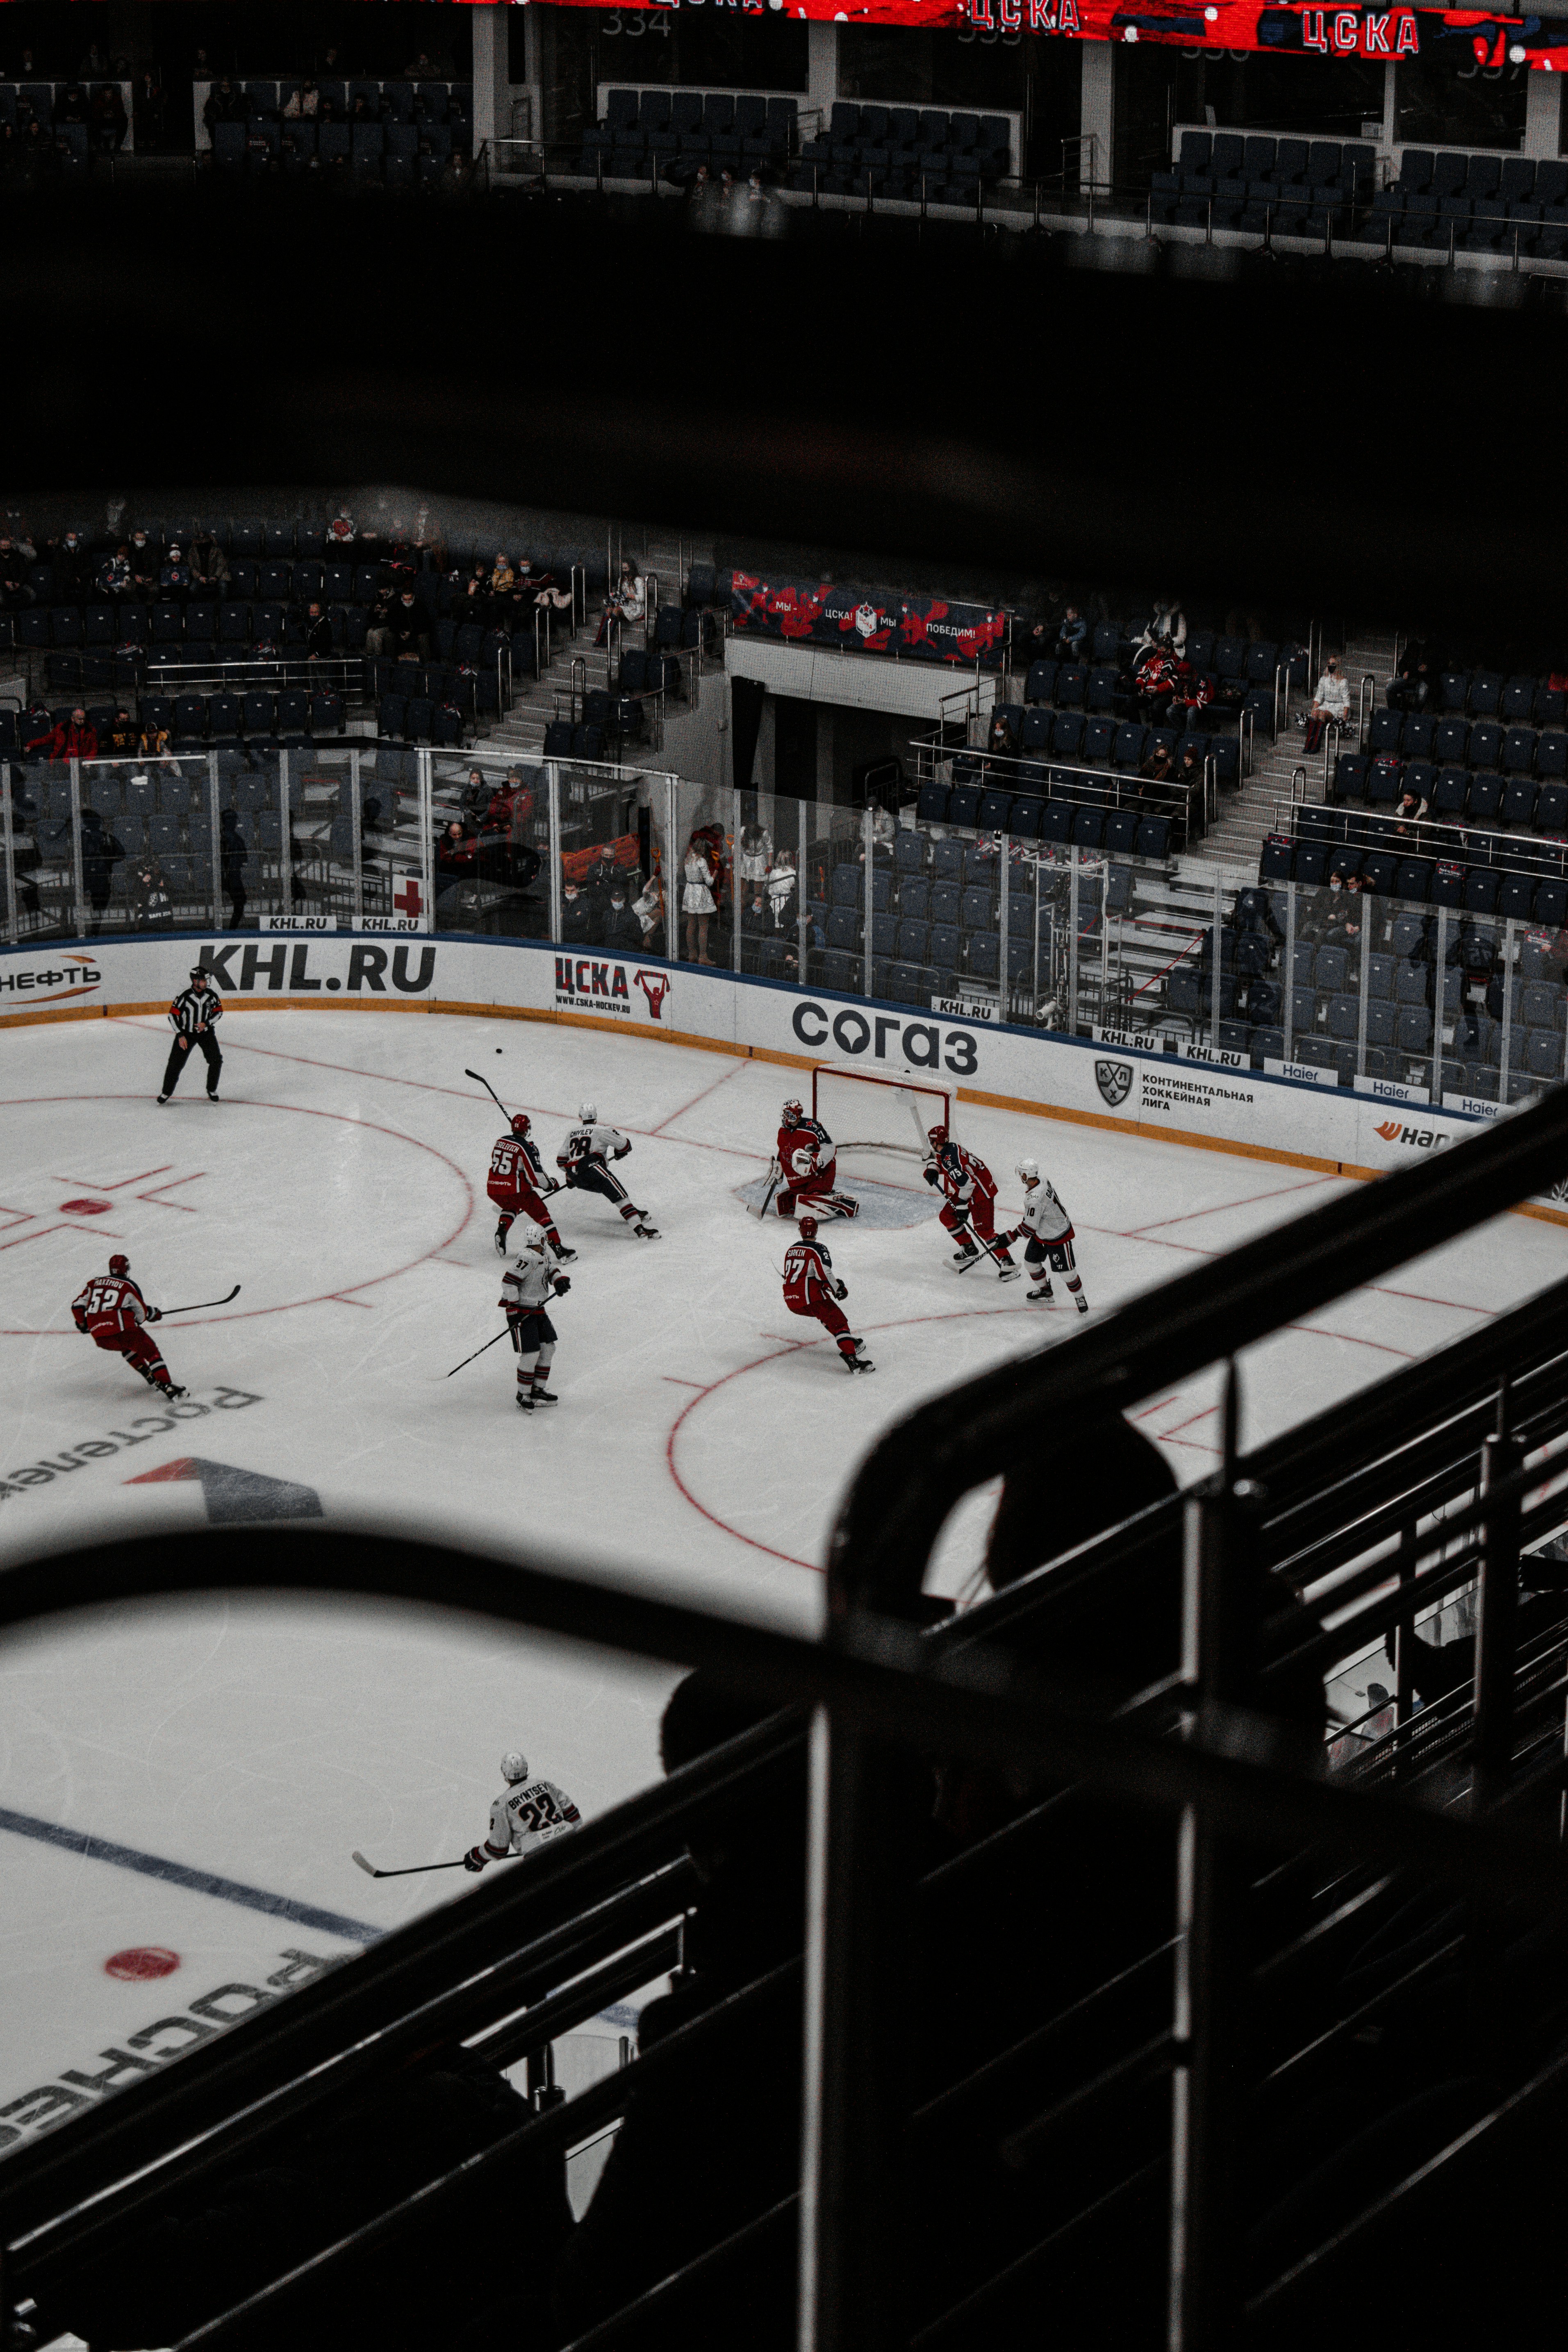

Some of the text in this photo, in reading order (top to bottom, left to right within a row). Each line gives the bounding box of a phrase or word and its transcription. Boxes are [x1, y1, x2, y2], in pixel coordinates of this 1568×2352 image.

[602, 8, 671, 37] 334
[1302, 9, 1420, 55] ЦСКА
[776, 601, 792, 611] МЫ
[825, 609, 853, 621] ЦСКА!
[880, 617, 976, 639] МЫ ПОБЕДИМ!
[269, 918, 327, 929] KHL.RU
[362, 919, 419, 931] KHL.RU
[198, 944, 436, 992] KHL.RU
[556, 958, 629, 999] ЦСКА
[556, 995, 630, 1014] WWW.CSKA-HOCKEY.RU
[939, 1000, 991, 1020] KHL.RU
[1101, 1029, 1155, 1050] KHL.RU
[1186, 1046, 1241, 1066] KHL.RU
[1283, 1064, 1318, 1081] Haier
[1142, 1074, 1254, 1103] КОНТИНЕНТАЛЬНАЯ
[1142, 1085, 1211, 1107] ХОККЕЙНАЯ
[1373, 1081, 1409, 1099] Haier
[1142, 1098, 1170, 1110] ЛИГА
[1462, 1099, 1497, 1117] Haier
[569, 1136, 592, 1158] 28
[492, 1149, 514, 1176] 55
[949, 1168, 962, 1180] 75
[1027, 1208, 1035, 1216] 10
[516, 1259, 528, 1270] 37
[785, 1259, 806, 1284] 27
[93, 1279, 125, 1290] MAXIMOV
[87, 1288, 120, 1314] 52
[519, 1792, 564, 1832] 22
[0, 1948, 348, 2150] РОСНЕ
